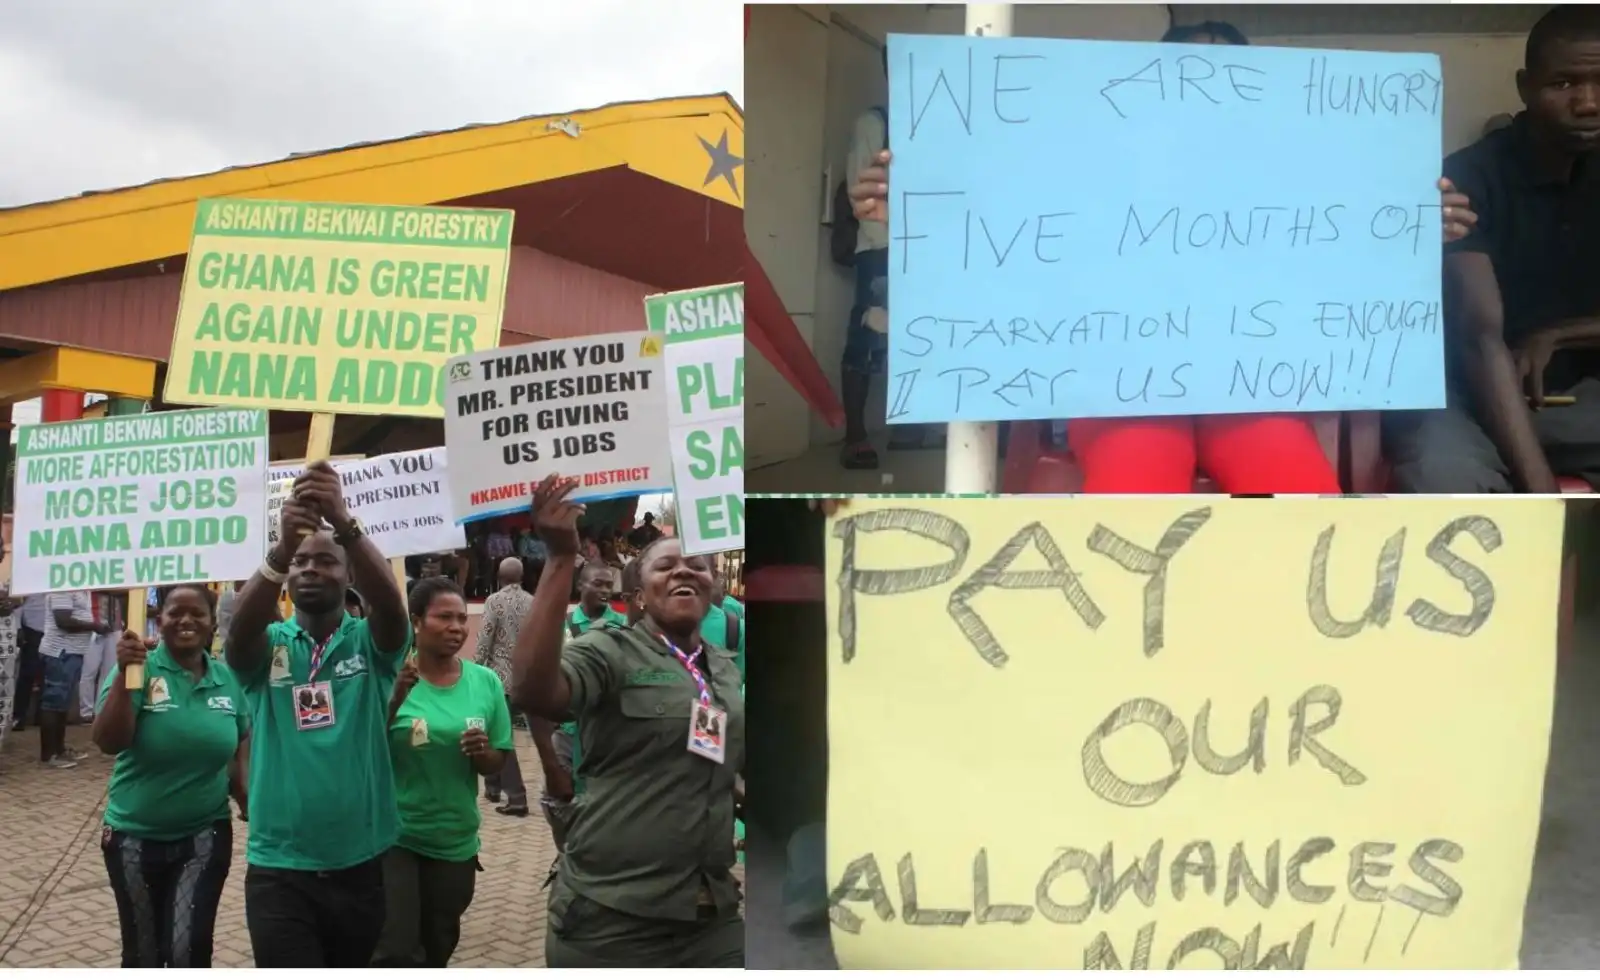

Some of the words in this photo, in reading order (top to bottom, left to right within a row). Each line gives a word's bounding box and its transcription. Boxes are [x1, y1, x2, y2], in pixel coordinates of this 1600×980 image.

[909, 48, 1046, 140] WE
[1100, 55, 1265, 119] ARE
[1303, 56, 1442, 116] HUNGRY
[205, 204, 297, 232] ASHANTI
[303, 208, 385, 237] BEKWAI
[391, 212, 503, 241] FORESTRY
[893, 191, 1076, 273] FIVE
[1117, 204, 1346, 256] MONTHS
[1371, 204, 1443, 256] OF
[198, 252, 315, 294] GHANA
[326, 258, 359, 296] IS
[370, 260, 489, 302] GREEN
[194, 302, 322, 346] AGAIN
[336, 309, 477, 354] UNDER
[900, 305, 1190, 356] STARVATION
[1231, 300, 1282, 337] IS
[1312, 300, 1438, 341] ENOUGH
[188, 351, 317, 400] NANA
[481, 348, 566, 380] THANK
[573, 342, 625, 367] YOU
[457, 389, 503, 417] MR.
[510, 370, 652, 406] PRESIDENT
[937, 367, 1077, 413] PAY
[1115, 363, 1193, 401] US
[27, 424, 98, 450] ASHANTI
[104, 416, 168, 444] BEKWAI
[173, 410, 260, 437] FORESTRY
[482, 411, 529, 441] FOR
[537, 401, 629, 430] GIVING
[26, 455, 84, 485] MORE
[89, 441, 256, 479] AFFORESTATION
[341, 465, 383, 487] HANK
[389, 453, 433, 475] YOU
[503, 441, 539, 465] US
[552, 431, 616, 459] JOBS
[45, 484, 138, 520] MORE
[150, 476, 237, 512] JOBS
[342, 480, 440, 509] R.PRESIDENT
[471, 483, 527, 505] NKAWIE
[584, 467, 650, 487] DISTRICT
[29, 522, 132, 558] NANA
[140, 515, 248, 549] ADDO
[364, 522, 389, 536] VING
[392, 518, 409, 530] US
[414, 515, 444, 528] JOBS
[50, 557, 124, 588] DONE
[134, 554, 208, 582] WELL
[833, 505, 1212, 668] PAY
[1306, 515, 1503, 639] US
[1081, 684, 1367, 808] OUR
[828, 836, 1464, 935] ALLOWANCES
